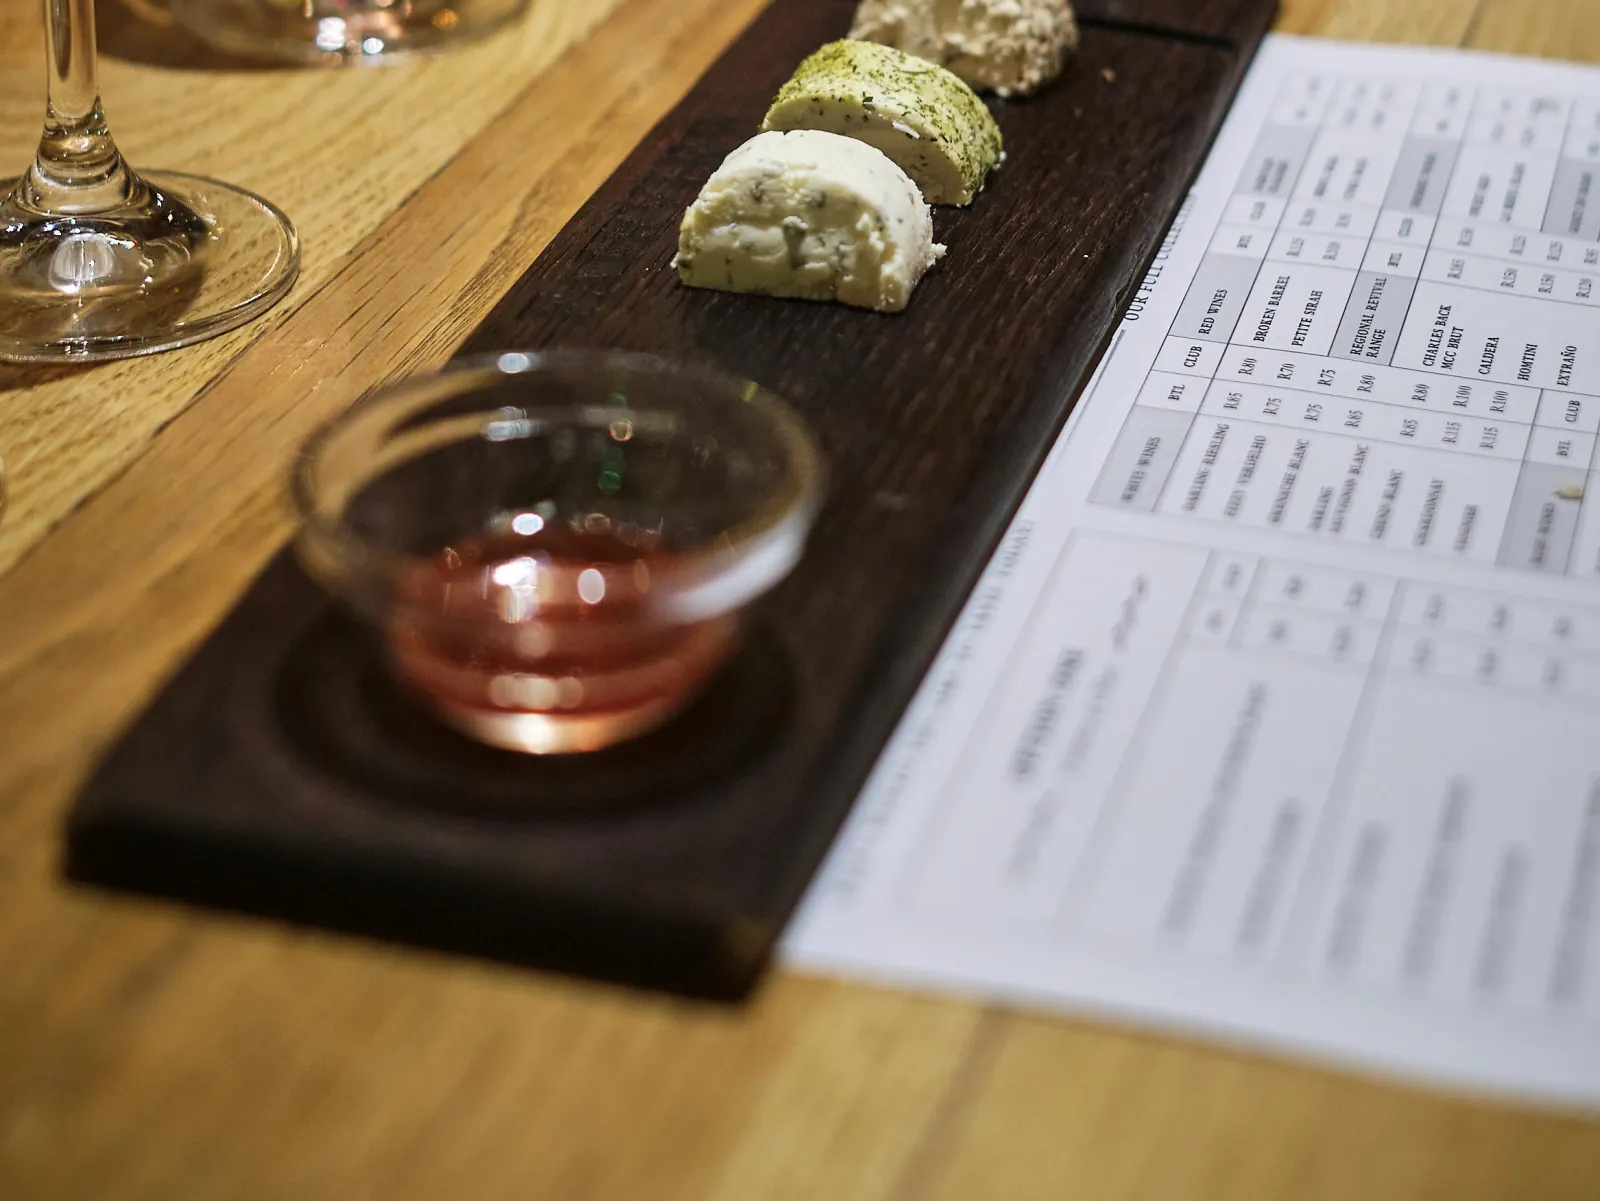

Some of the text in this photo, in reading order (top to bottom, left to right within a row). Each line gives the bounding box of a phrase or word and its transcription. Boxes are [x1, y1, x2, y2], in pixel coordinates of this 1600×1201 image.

[1124, 294, 1149, 321] OUR
[1139, 263, 1164, 293] FULL
[1198, 289, 1228, 335] RED WINES
[1253, 276, 1290, 342] BROKEN BARREL
[1291, 290, 1323, 347] PETITE SIRAH
[1350, 278, 1387, 355] REGIONAL REVIVAL
[1366, 329, 1386, 358] RANGE
[1422, 305, 1451, 366] CHARLES BACK
[1183, 346, 1202, 368] CLUB
[1441, 326, 1464, 370] MCC BRUT
[1478, 337, 1499, 375] CALDERA
[1238, 358, 1257, 375] R80
[1277, 363, 1295, 380] R70
[1517, 343, 1538, 381] HOMTINI
[1556, 346, 1577, 386] EXTRAÑO
[1317, 369, 1336, 386] R75
[1357, 375, 1375, 393] R80
[1168, 385, 1185, 401] BTL
[1223, 392, 1242, 410] R85
[1411, 384, 1429, 402] R80
[1452, 385, 1472, 408] R100
[1489, 391, 1508, 413] R100
[1263, 398, 1282, 415] R75
[1304, 404, 1322, 421] R75
[1565, 400, 1580, 422] CLUB
[1344, 410, 1363, 428] R85
[1399, 419, 1418, 437] R85
[1441, 421, 1461, 444] R115
[1479, 427, 1498, 449] R115
[1137, 437, 1161, 466] WINES
[1202, 424, 1229, 465] RIESLING
[1287, 439, 1309, 470] BLANC
[1556, 441, 1571, 457] BTL
[1237, 435, 1266, 484] VERDELHO
[1348, 445, 1369, 476] BLANC
